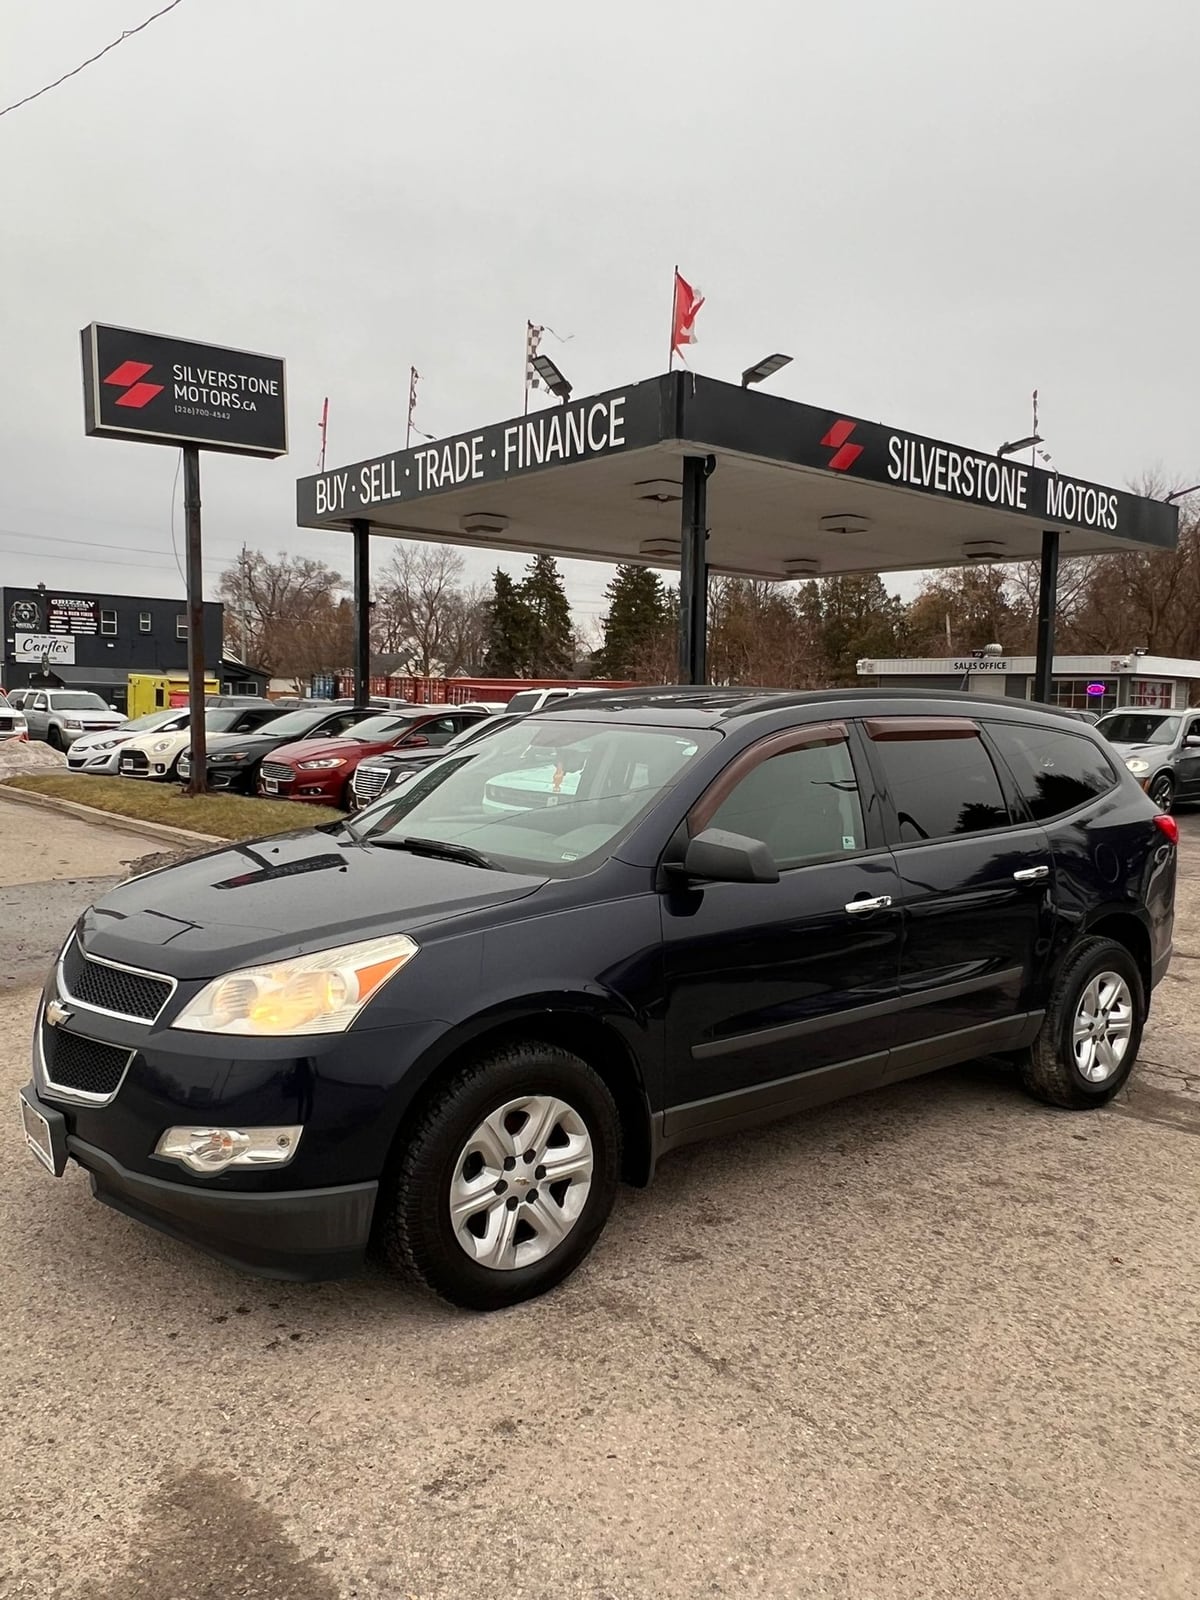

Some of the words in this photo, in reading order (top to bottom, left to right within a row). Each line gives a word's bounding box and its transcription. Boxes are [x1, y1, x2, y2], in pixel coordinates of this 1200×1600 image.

[172, 364, 279, 396] SILVERSTONE
[316, 473, 349, 515] BUY
[360, 460, 401, 505] SELL
[414, 436, 484, 491] TRADE
[503, 397, 626, 472] FINANCE
[887, 435, 1028, 510] SILVERSTONE
[1046, 479, 1118, 530] MOTORS
[23, 638, 68, 656] Carflex
[953, 662, 978, 670] SALES
[979, 662, 1007, 670] OFFICE
